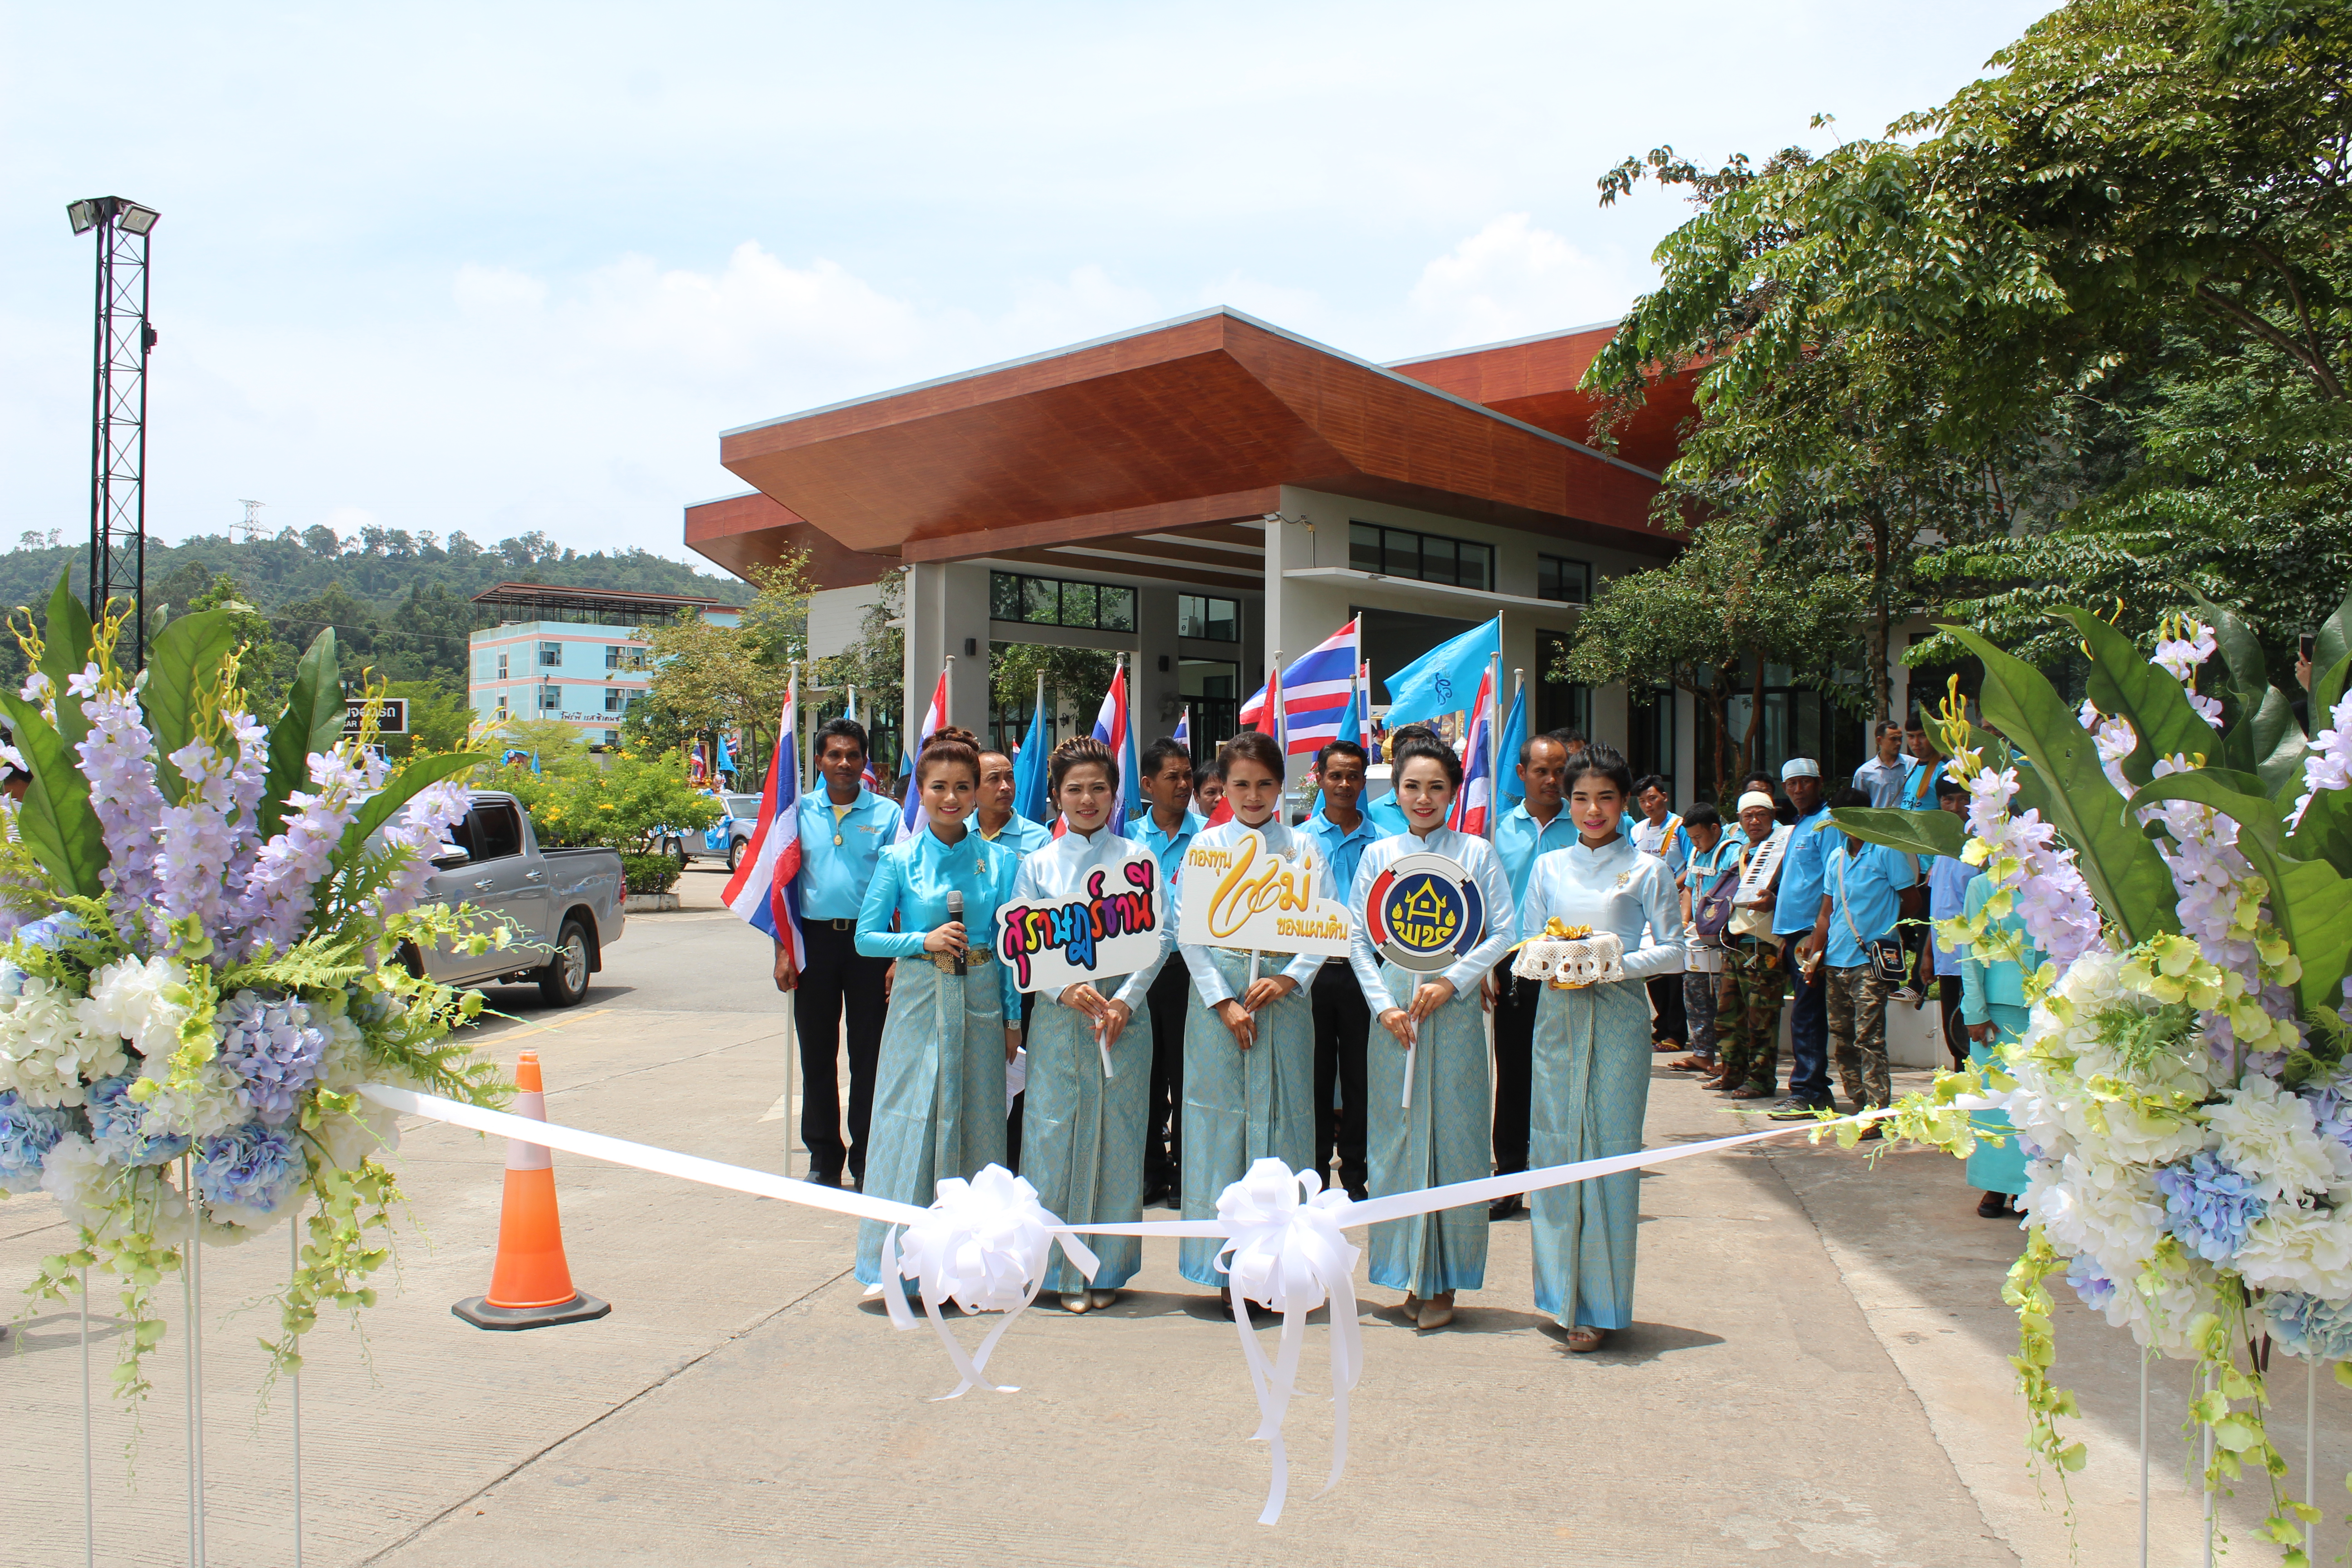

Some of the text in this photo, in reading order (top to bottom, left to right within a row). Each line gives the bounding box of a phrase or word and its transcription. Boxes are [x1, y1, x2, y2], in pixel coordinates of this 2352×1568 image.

[1188, 849, 1232, 877] กองทุน
[1276, 904, 1348, 940] ของแผ่นดิน
